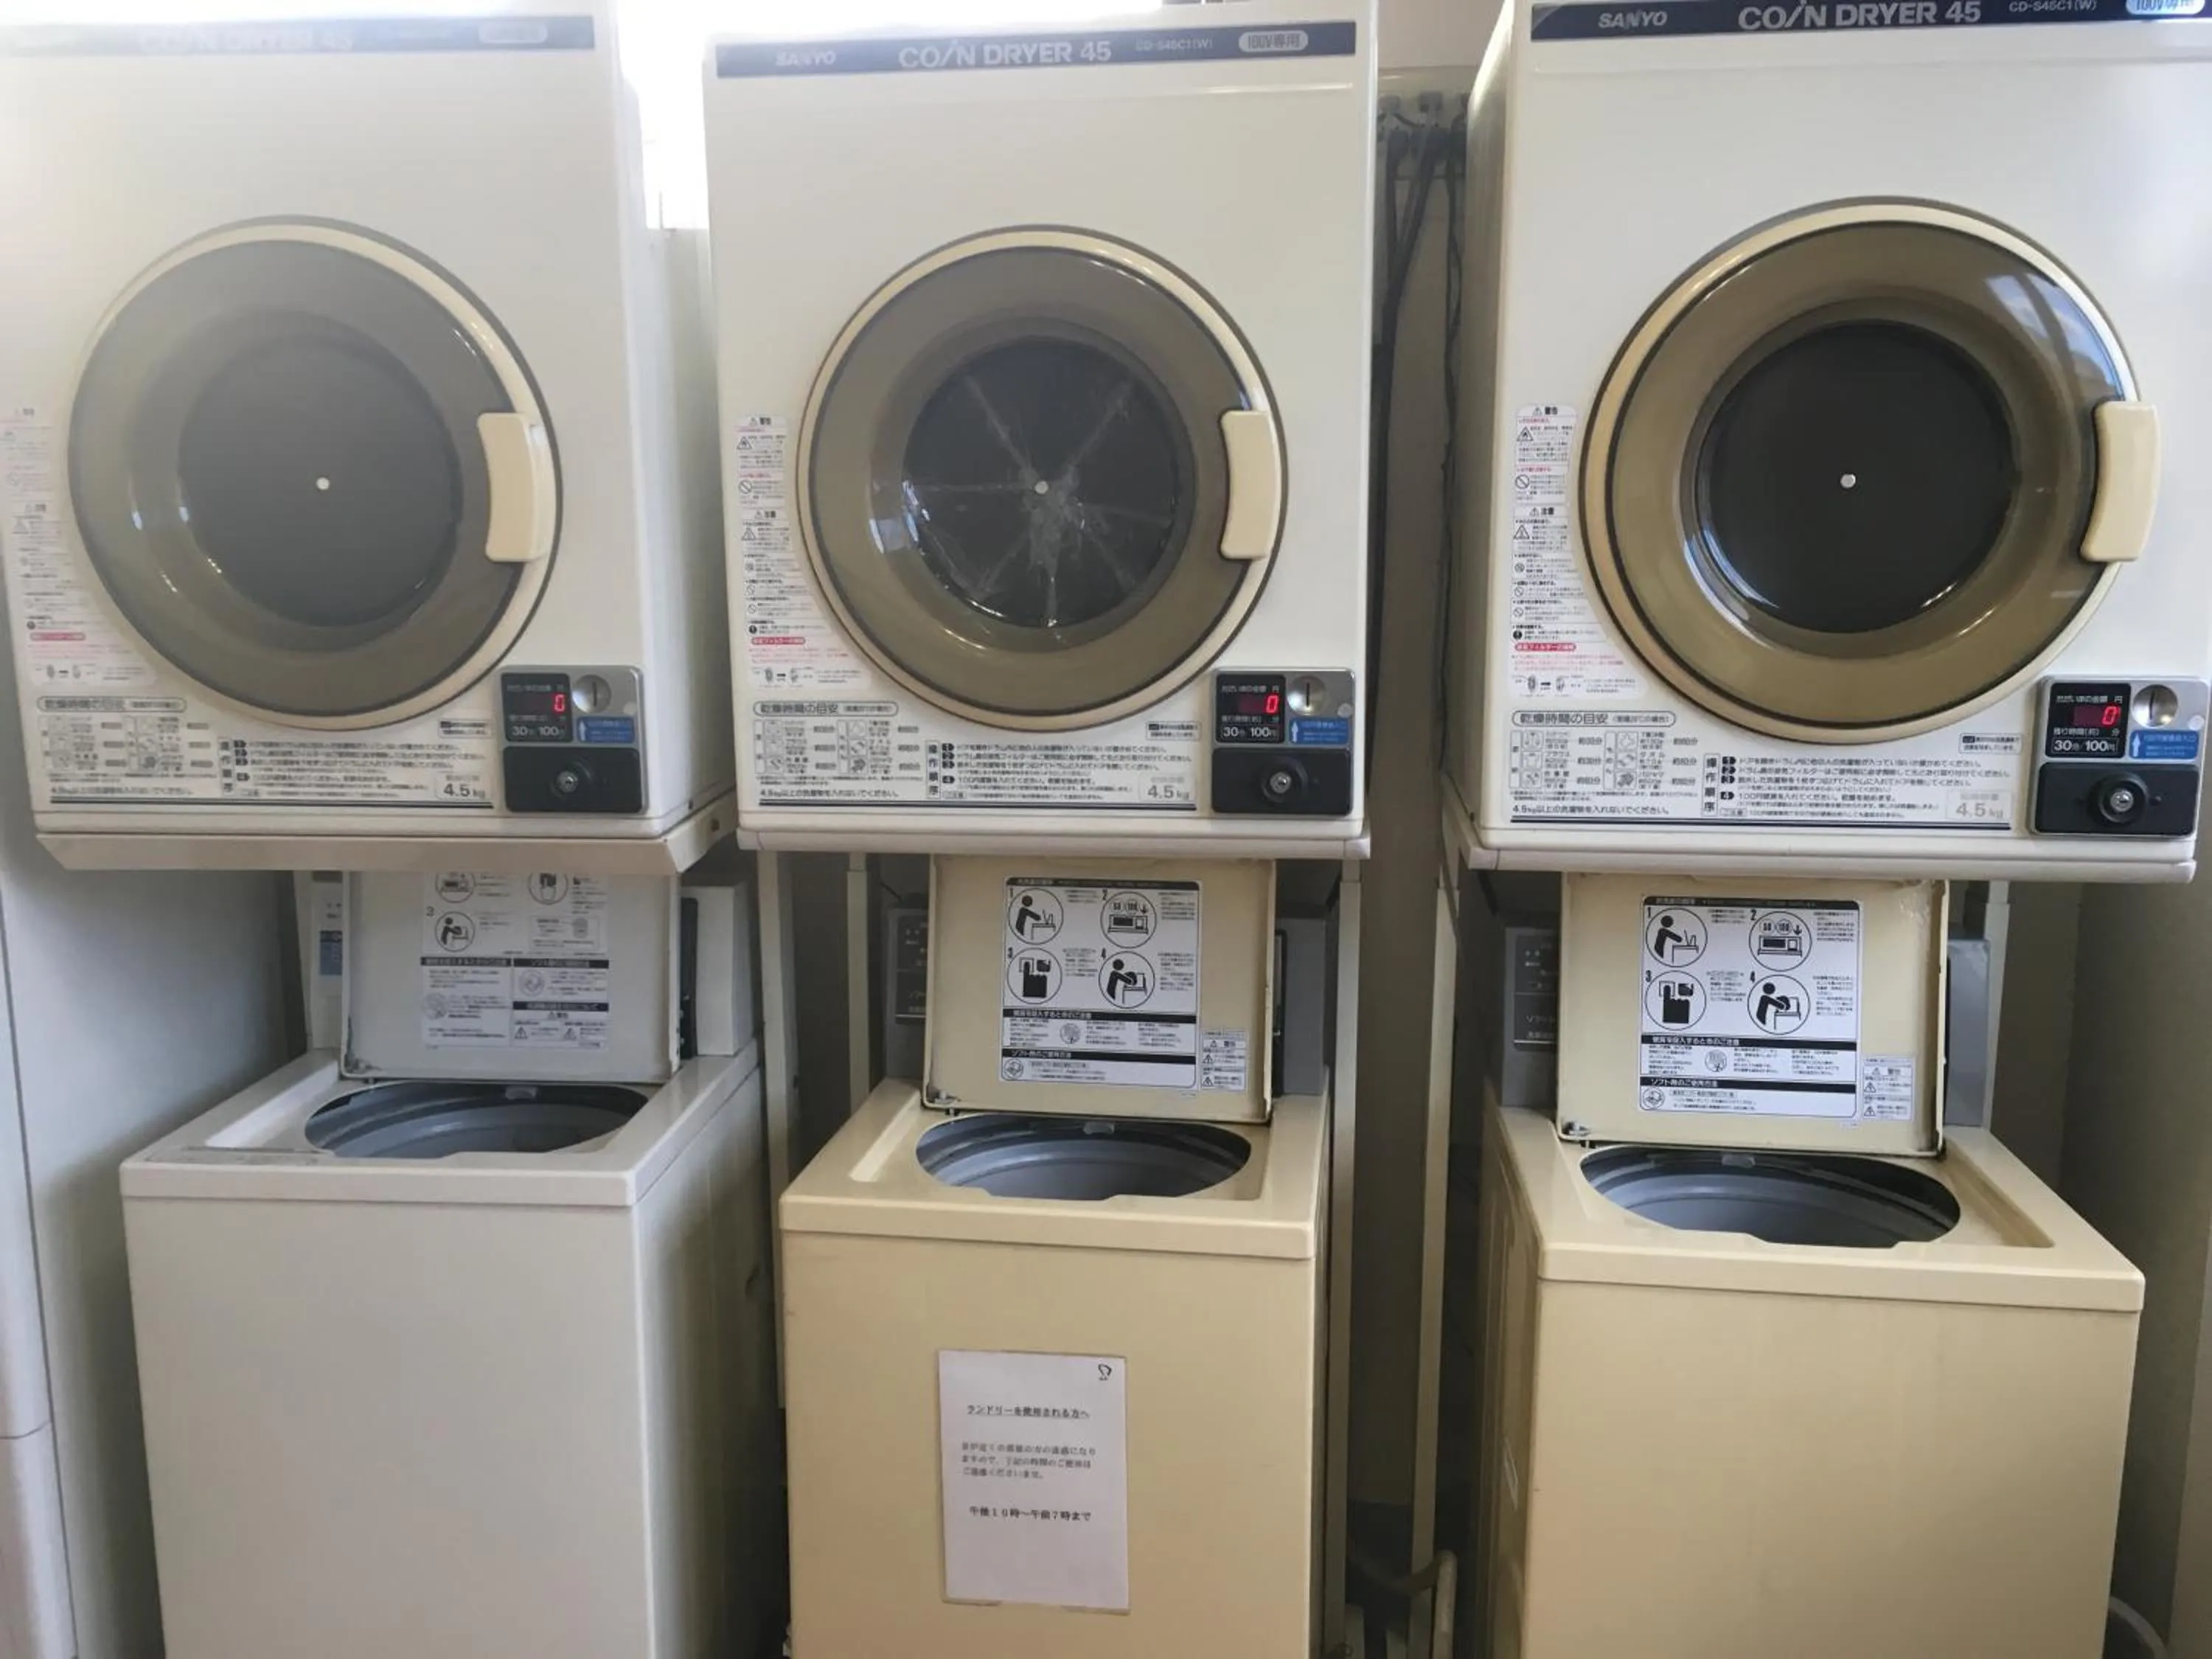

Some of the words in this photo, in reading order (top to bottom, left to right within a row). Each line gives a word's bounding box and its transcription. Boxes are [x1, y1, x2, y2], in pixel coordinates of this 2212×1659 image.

[1597, 10, 1667, 28] SANYO
[1737, 1, 1826, 31] COIN
[1834, 2, 1935, 27] DRYER
[1944, 2, 1981, 23] 45
[776, 51, 837, 67] SANYO
[898, 39, 976, 69] COIN
[984, 41, 1074, 66] DRYER
[1079, 41, 1112, 62] 45
[554, 693, 566, 712] 0
[1266, 695, 1279, 714] 0
[2102, 706, 2118, 725] 0
